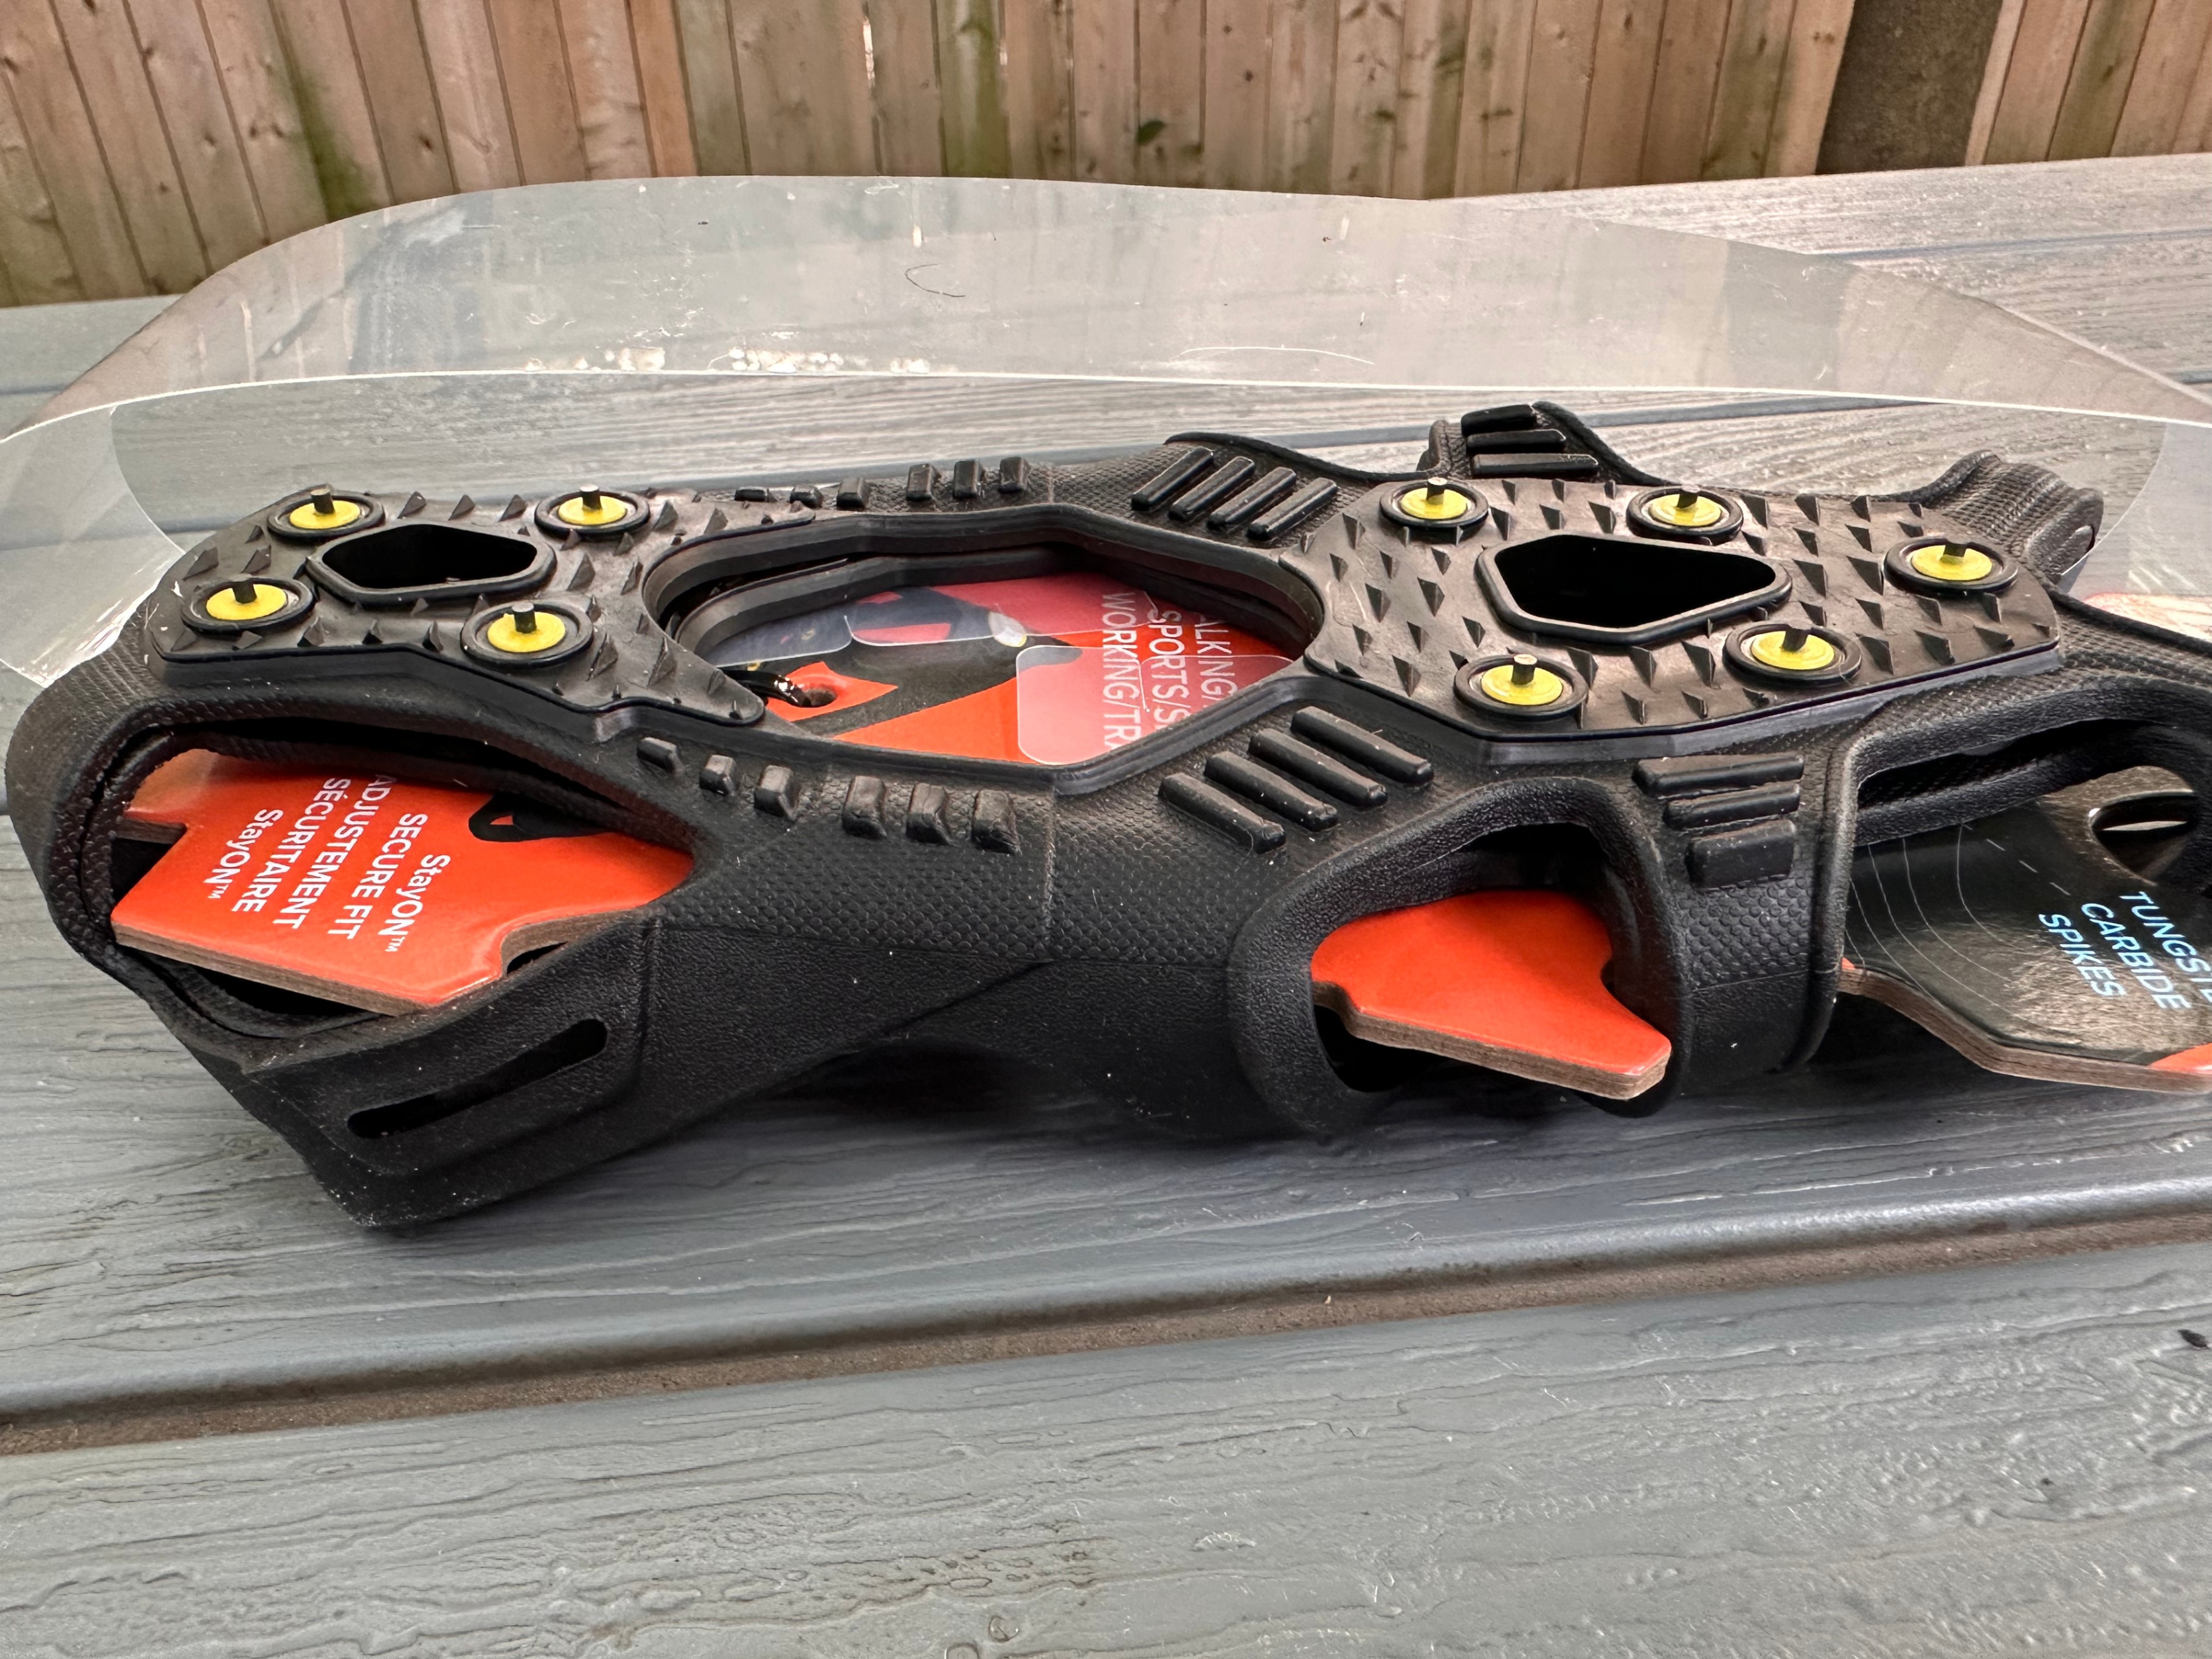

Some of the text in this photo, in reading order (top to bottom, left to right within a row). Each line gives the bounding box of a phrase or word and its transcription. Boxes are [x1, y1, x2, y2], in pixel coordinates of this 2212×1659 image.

[1147, 610, 1191, 730] SPORTS/S
[1194, 612, 1238, 708] ALKING/
[231, 777, 351, 912] SÉCURITAIRE
[272, 774, 398, 929] ADJUSTEMENT
[328, 813, 428, 940] SECURE FIT
[2038, 913, 2127, 996] SPIKES
[2081, 903, 2192, 1009] CARBIDE
[2119, 890, 2212, 1003] TUNGS
